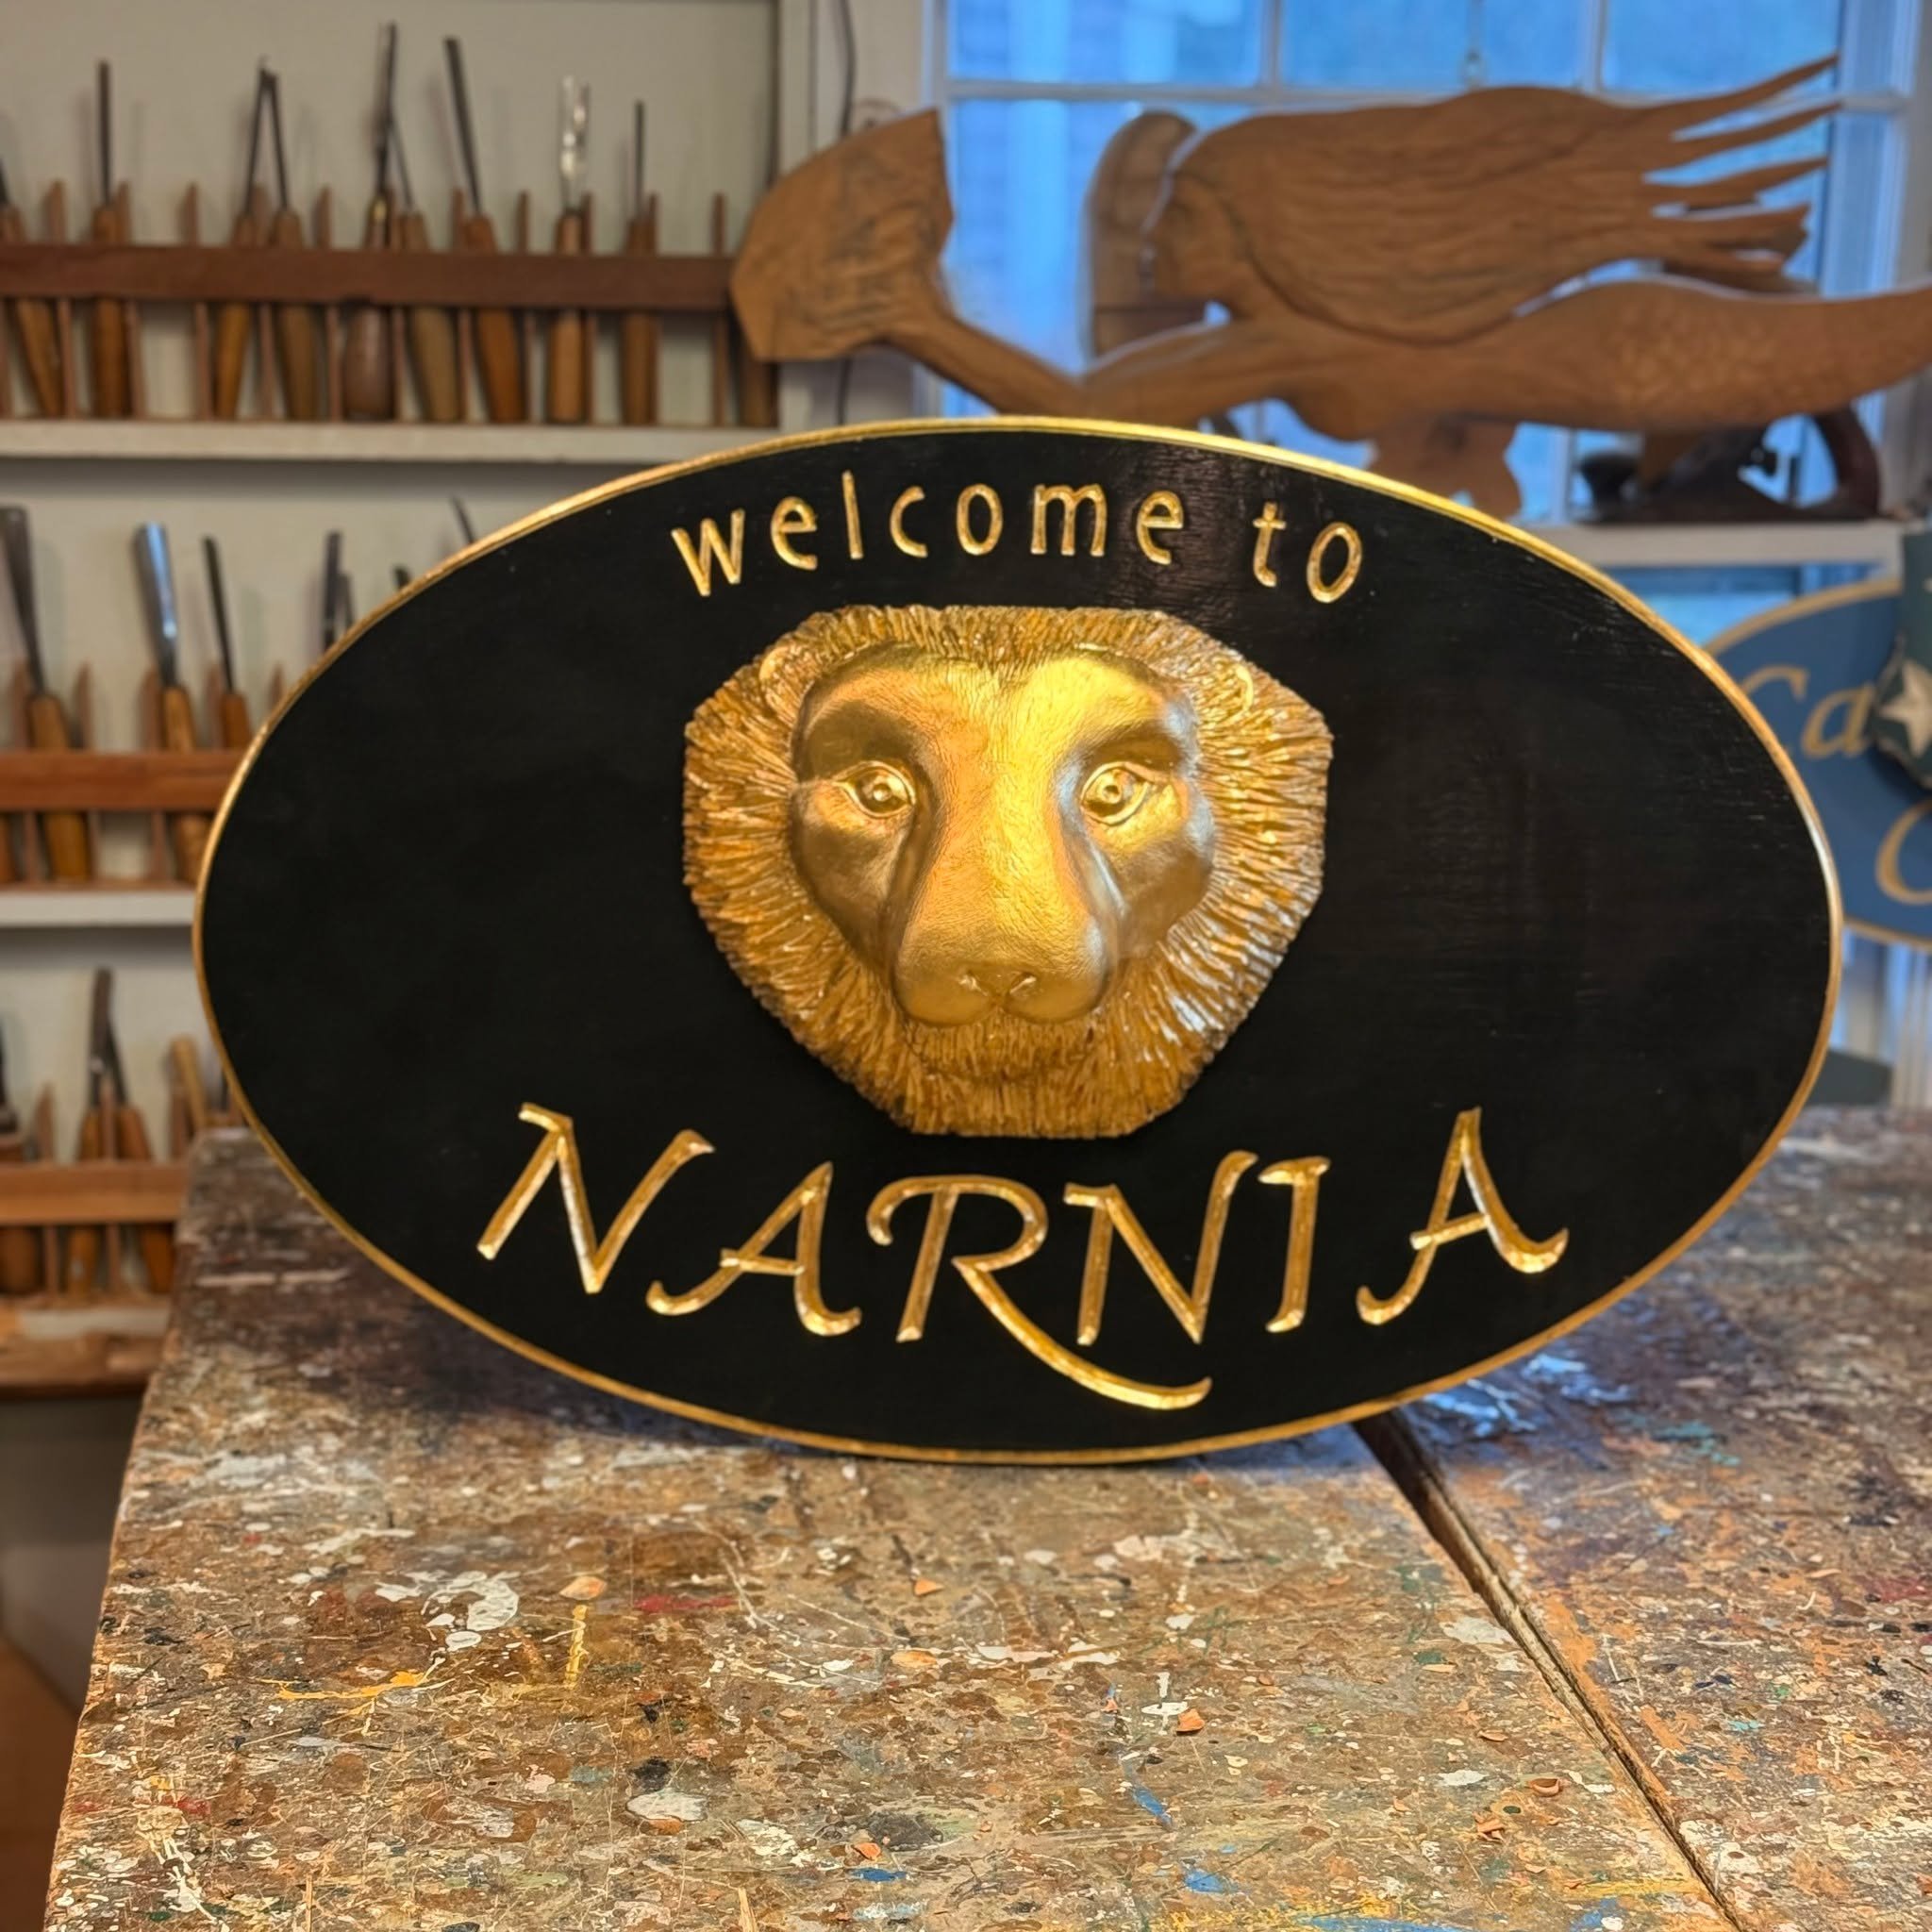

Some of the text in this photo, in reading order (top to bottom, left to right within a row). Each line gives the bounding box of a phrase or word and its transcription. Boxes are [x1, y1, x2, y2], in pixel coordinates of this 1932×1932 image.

[670, 470, 1364, 605] welcome to
[475, 1102, 1570, 1412] NARNIA
